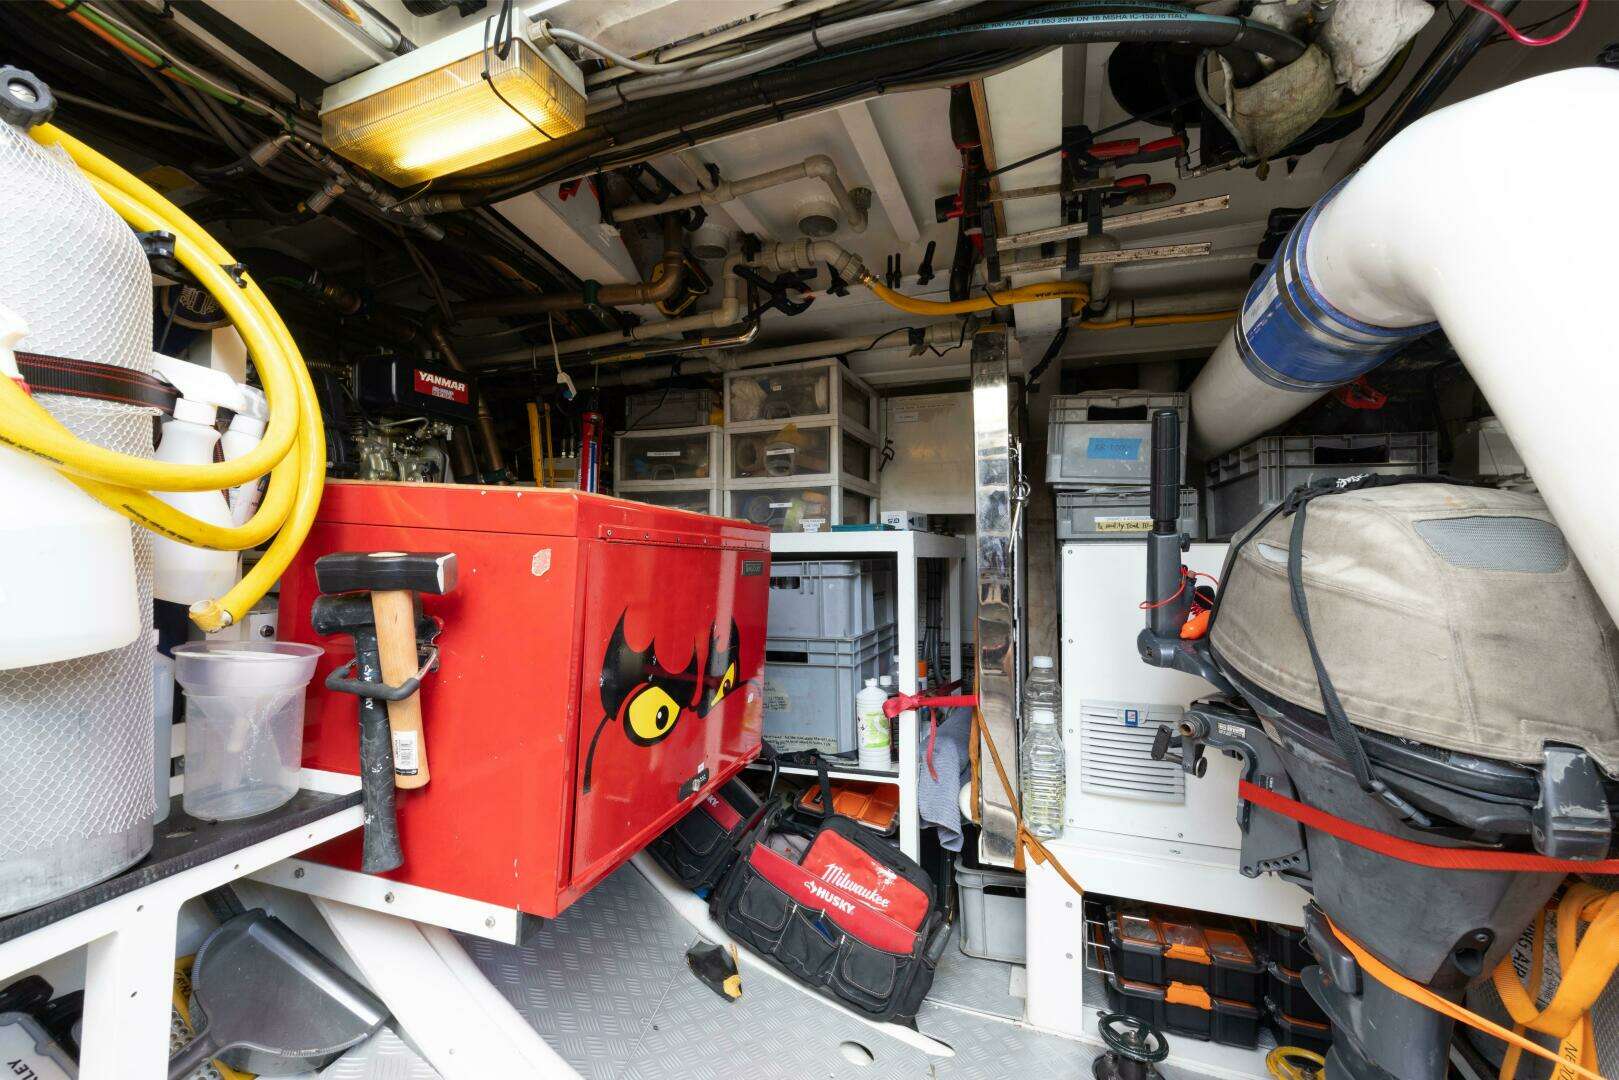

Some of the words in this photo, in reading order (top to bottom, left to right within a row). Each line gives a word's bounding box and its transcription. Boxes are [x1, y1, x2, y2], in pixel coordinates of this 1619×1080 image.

[1101, 13, 1128, 21] MSHA
[419, 370, 466, 391] YANMAR
[820, 863, 891, 908] Milwaukee
[816, 886, 856, 914] HUSKY
